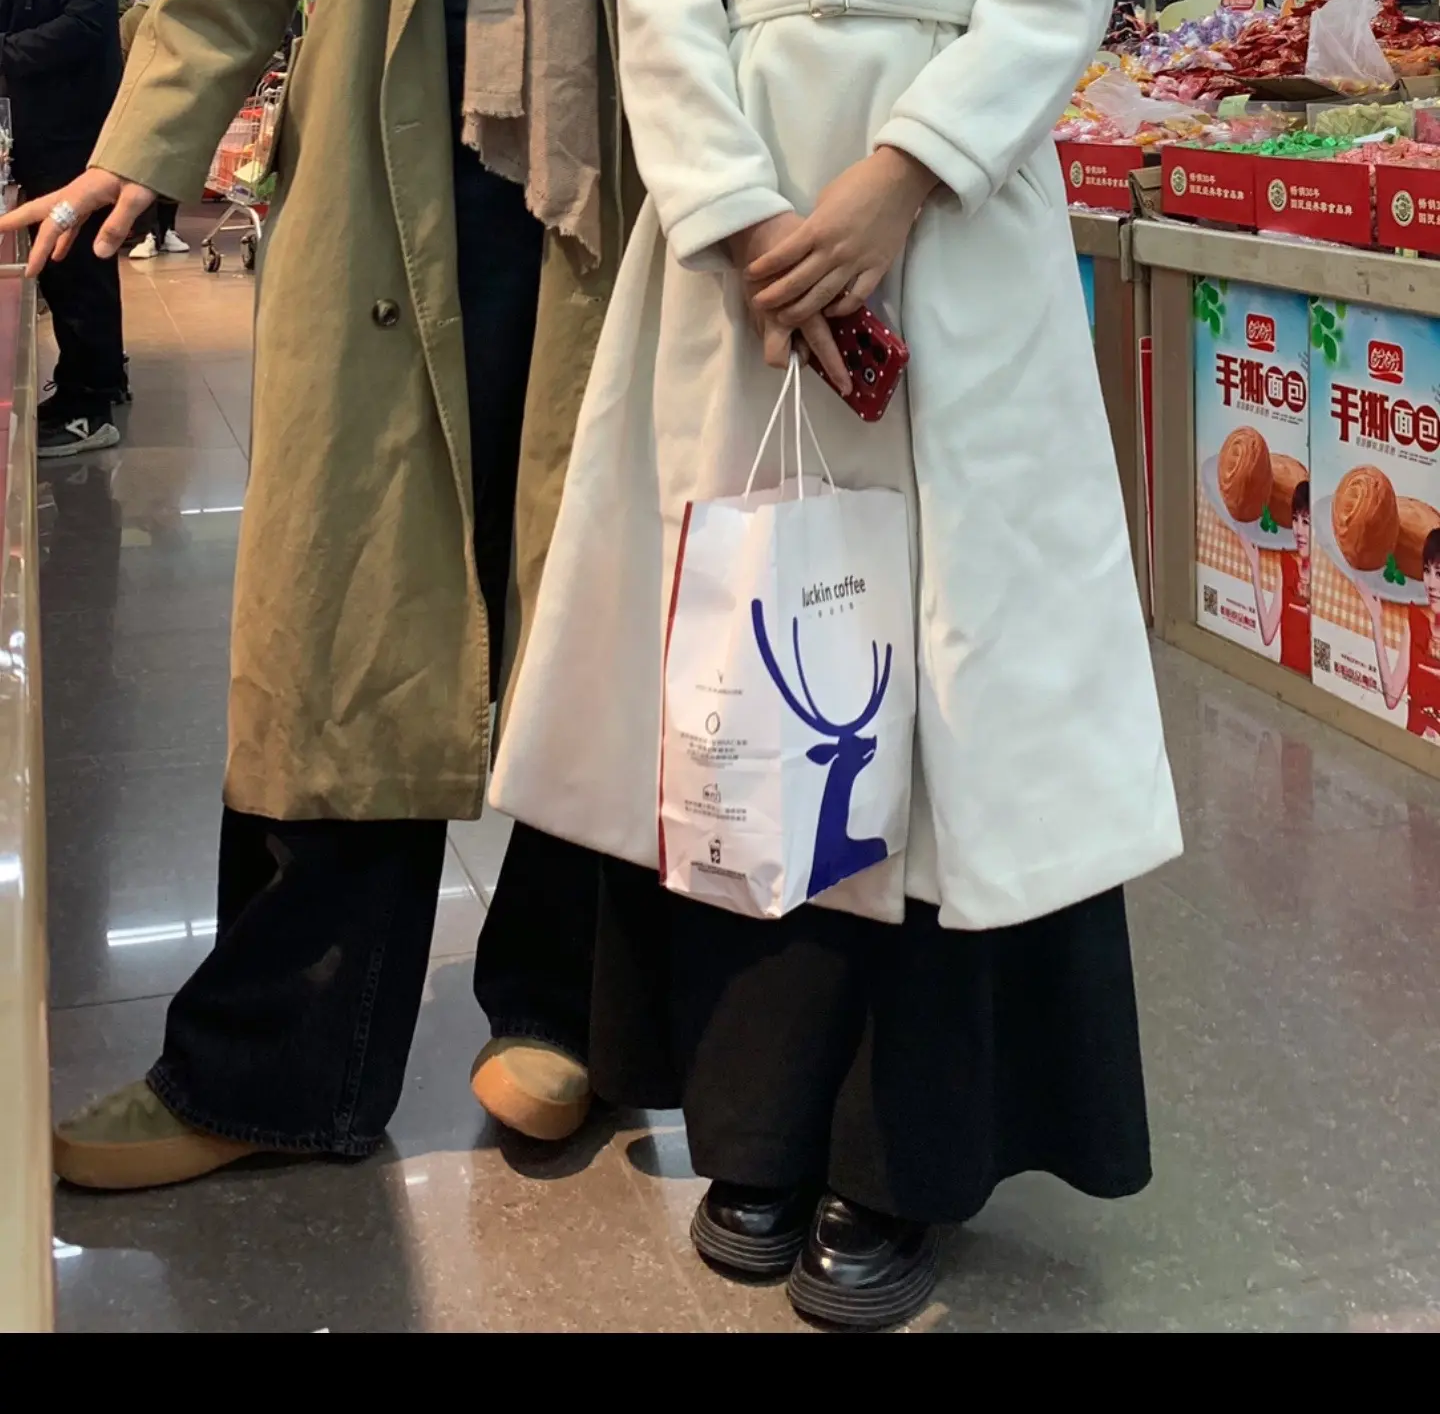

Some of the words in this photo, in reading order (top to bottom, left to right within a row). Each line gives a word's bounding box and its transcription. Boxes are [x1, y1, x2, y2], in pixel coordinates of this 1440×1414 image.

[1216, 353, 1305, 411] 手撕面包
[1331, 383, 1440, 448] 手撕面包
[802, 582, 832, 608] luckin
[834, 575, 866, 599] coffee
